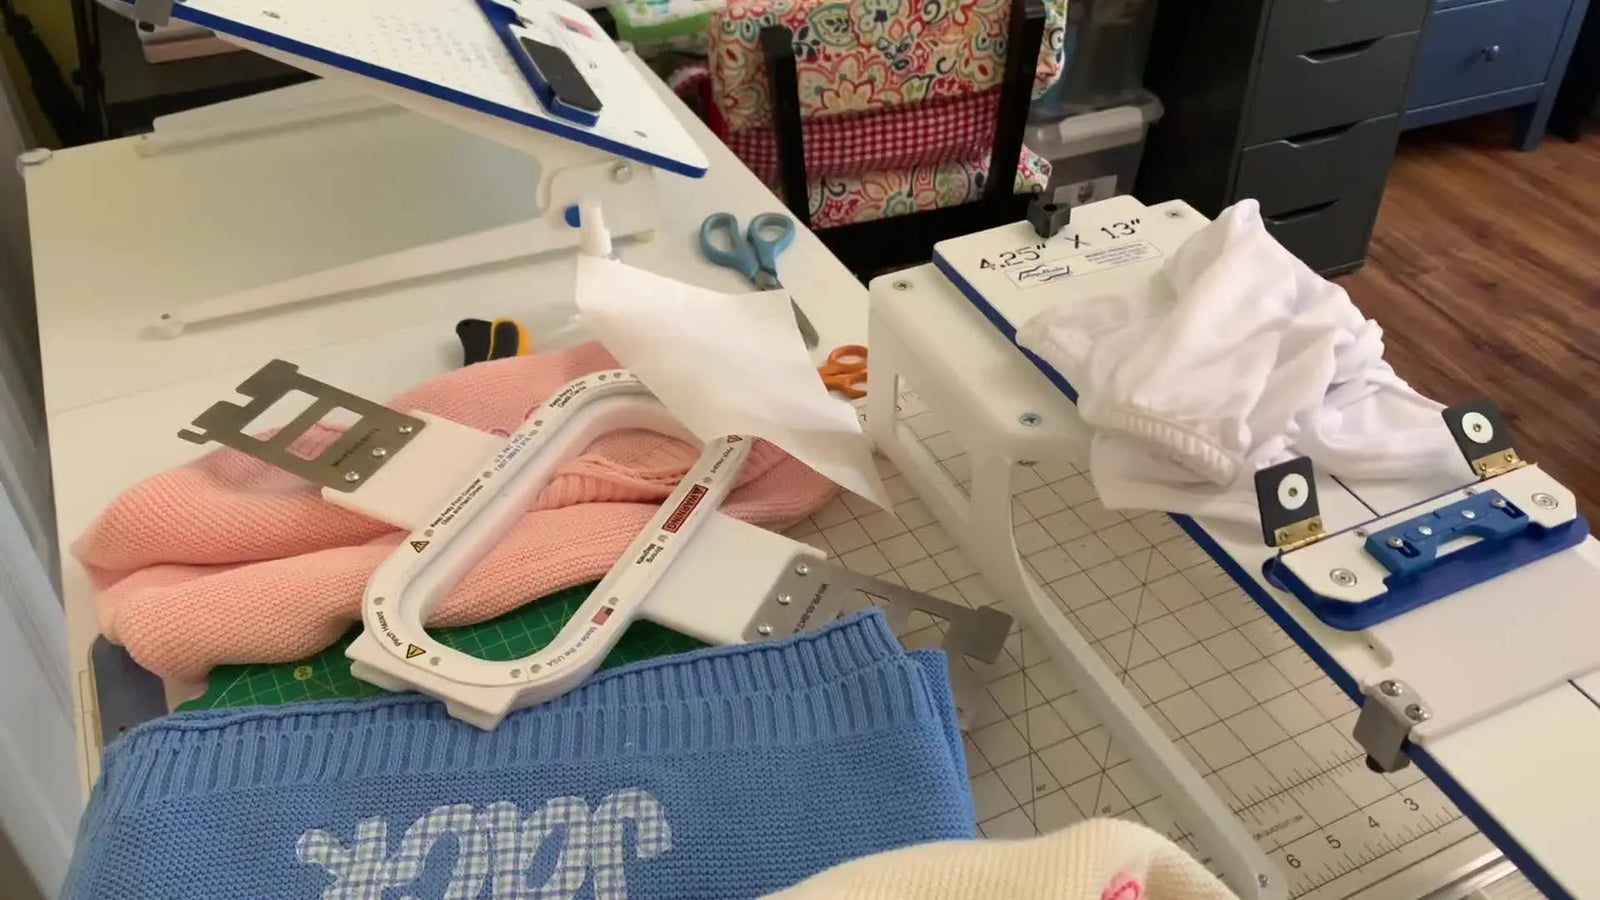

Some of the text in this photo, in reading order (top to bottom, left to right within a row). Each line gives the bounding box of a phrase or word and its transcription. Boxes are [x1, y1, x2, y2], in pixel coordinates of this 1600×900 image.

[667, 489, 702, 530] WARNING
[376, 611, 403, 647] Pinch Hazard
[1286, 797, 1420, 869] 6 5 4 3
